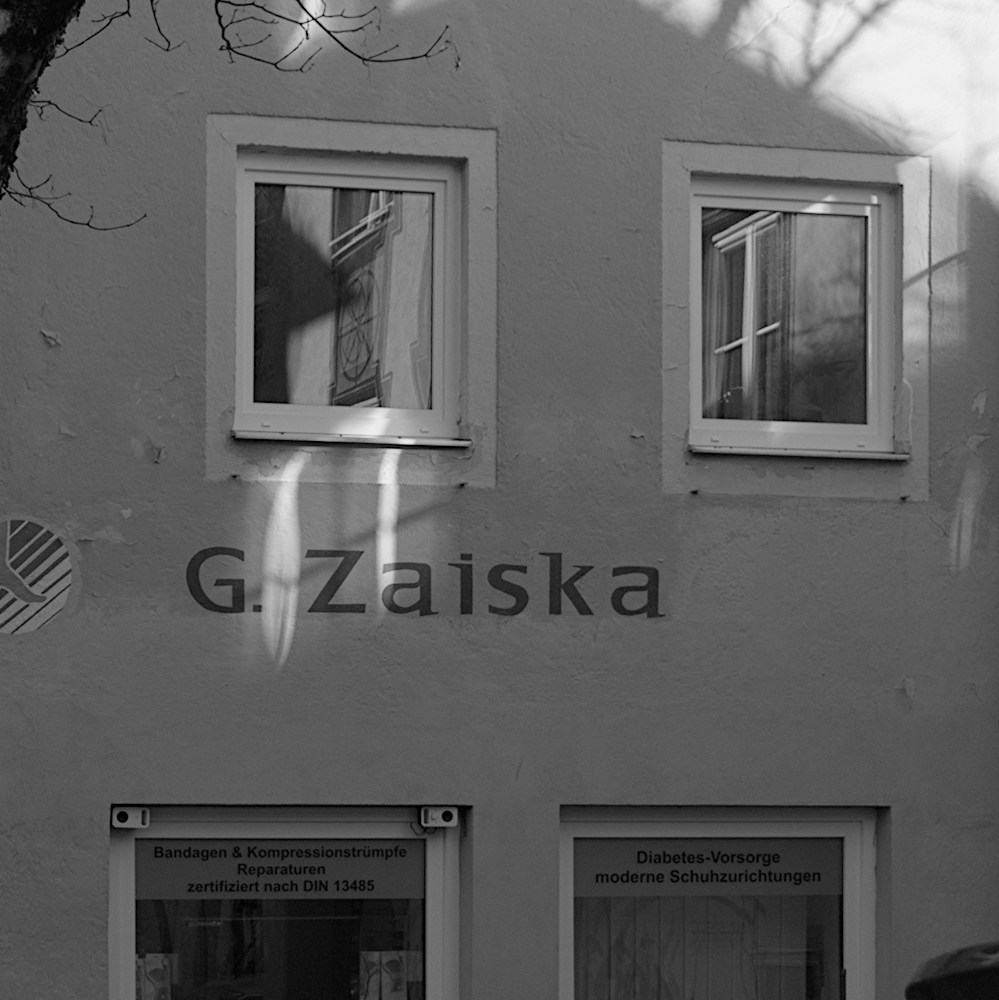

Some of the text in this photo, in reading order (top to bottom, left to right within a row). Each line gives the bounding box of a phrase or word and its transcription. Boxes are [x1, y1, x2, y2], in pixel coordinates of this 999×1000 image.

[185, 546, 667, 618] G. Zaiska
[154, 845, 407, 861] Bandagen & Kompressionstrümpfe
[636, 851, 781, 867] Diabetes-Vorsorge
[237, 863, 326, 878] Reparaturen
[595, 870, 821, 886] moderne Schuhzurichtungen
[187, 879, 375, 893] zertifiziert nach DIN 13485
